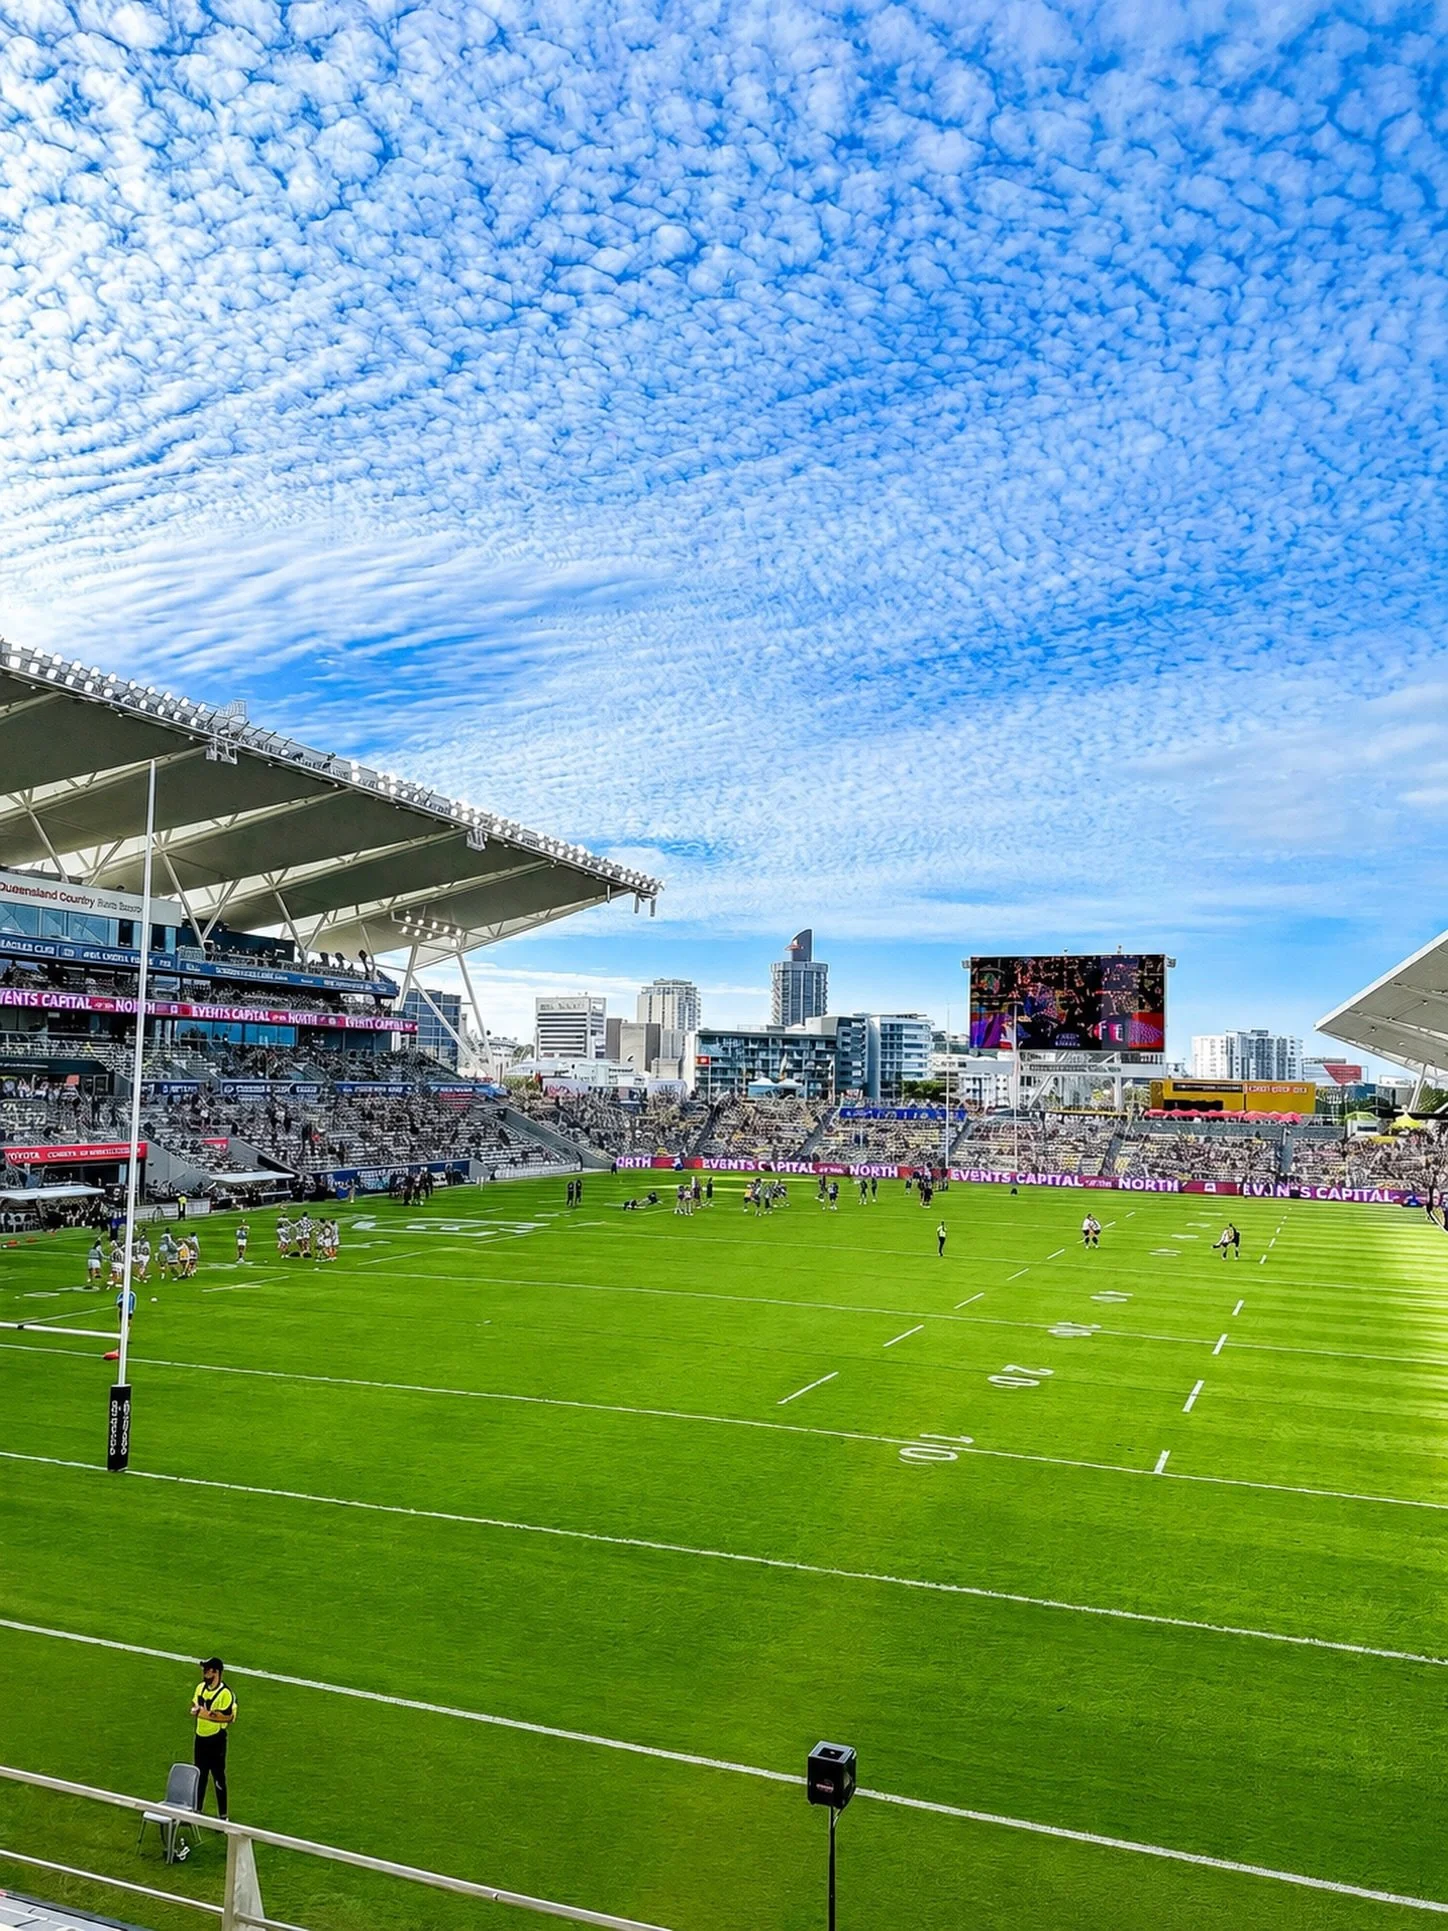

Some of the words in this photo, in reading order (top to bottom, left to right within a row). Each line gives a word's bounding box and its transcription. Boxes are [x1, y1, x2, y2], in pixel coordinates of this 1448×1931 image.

[0, 882, 58, 901] Queensland
[59, 892, 95, 909] Country
[41, 994, 92, 1010] CAPITAL
[192, 1005, 230, 1019] EVENTS
[232, 1008, 271, 1022] CAPITAL
[288, 1013, 318, 1025] NORTH
[7, 1151, 41, 1160] TOYOTA
[702, 1158, 755, 1171] EVENTS
[849, 1164, 898, 1178] NORTH
[950, 1169, 1011, 1183] EVENTS
[1016, 1172, 1084, 1187] CAPITAL
[1118, 1177, 1180, 1192] NORTH
[1243, 1183, 1312, 1199] EVNS
[1316, 1187, 1394, 1203] CAPITAL
